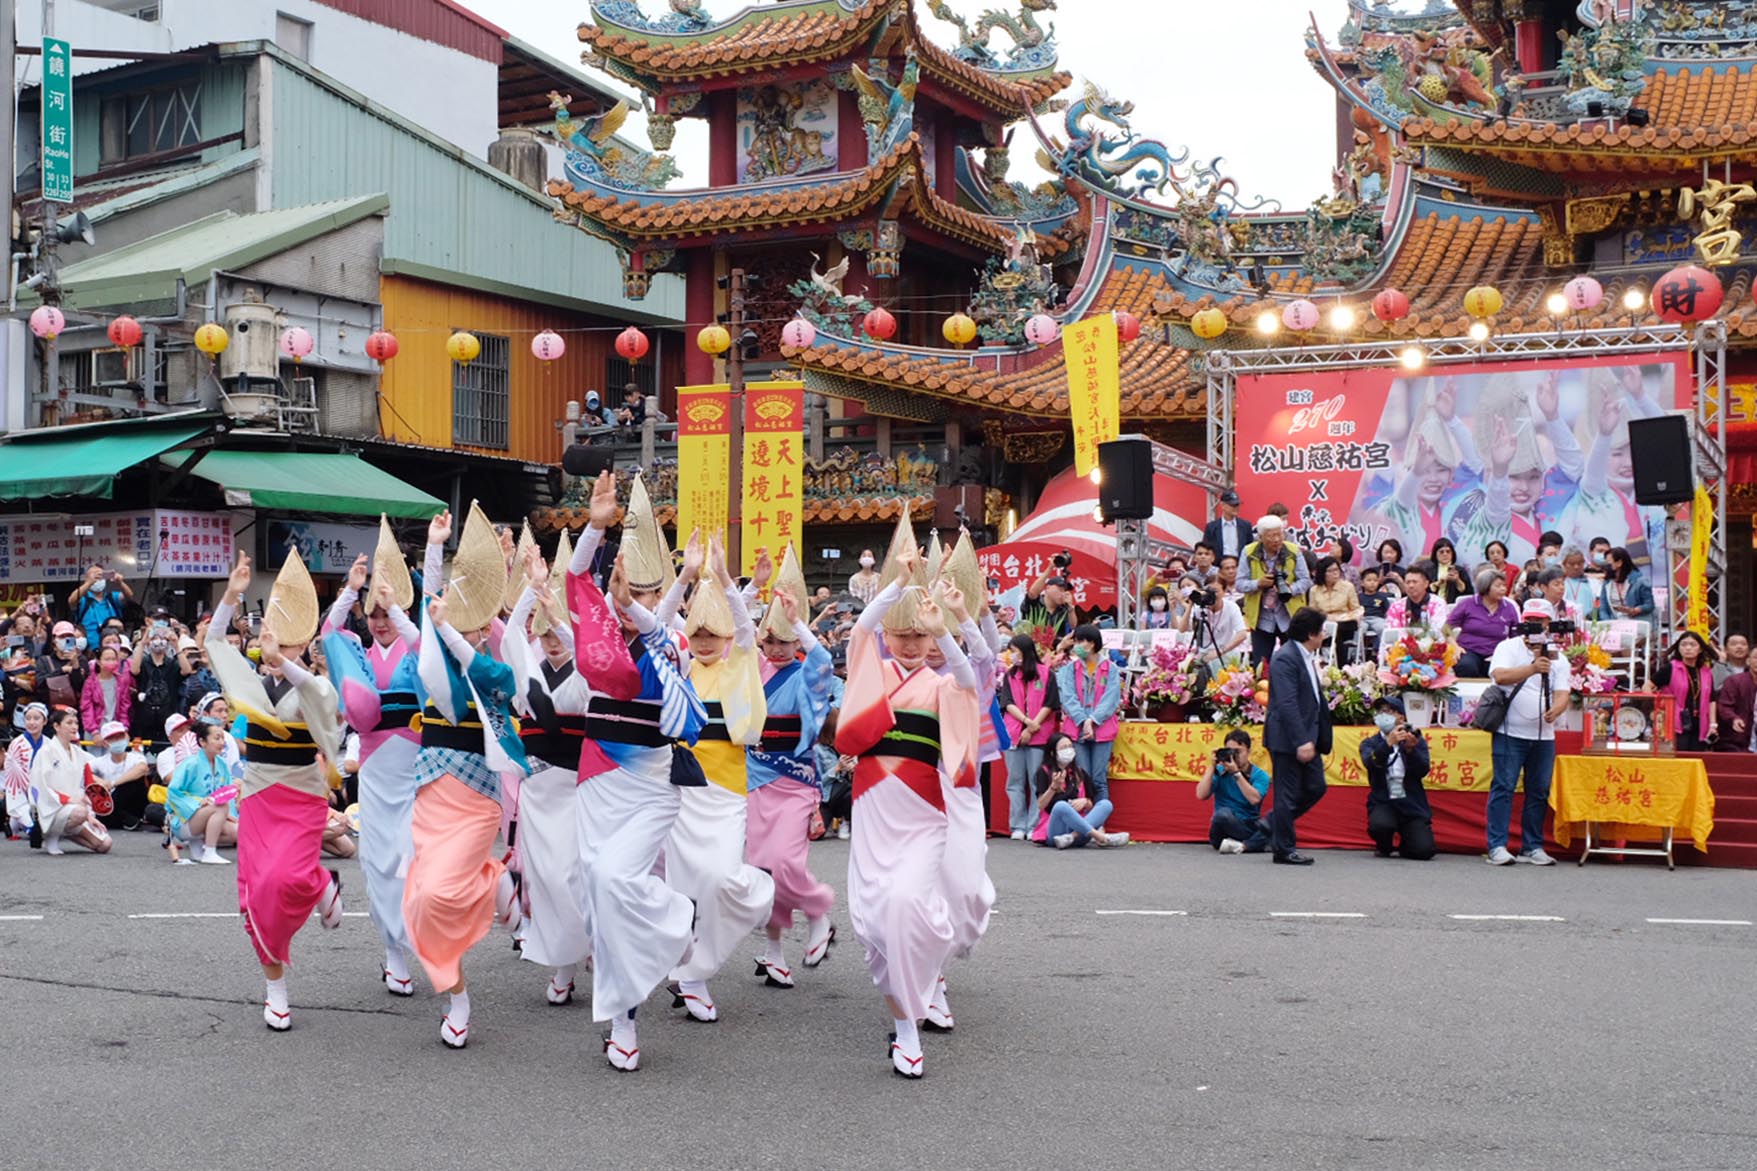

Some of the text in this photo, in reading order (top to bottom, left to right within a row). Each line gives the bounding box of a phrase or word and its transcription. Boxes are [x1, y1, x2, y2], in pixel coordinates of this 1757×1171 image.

[1661, 277, 1704, 317] 財
[1288, 394, 1345, 435] 270
[1251, 442, 1391, 472] 松山慈祐宮
[1154, 727, 1217, 745] 台北市
[1109, 751, 1208, 777] 松山慈祐
[1606, 765, 1645, 784] 松山
[1595, 785, 1657, 808] 慈祐宮
